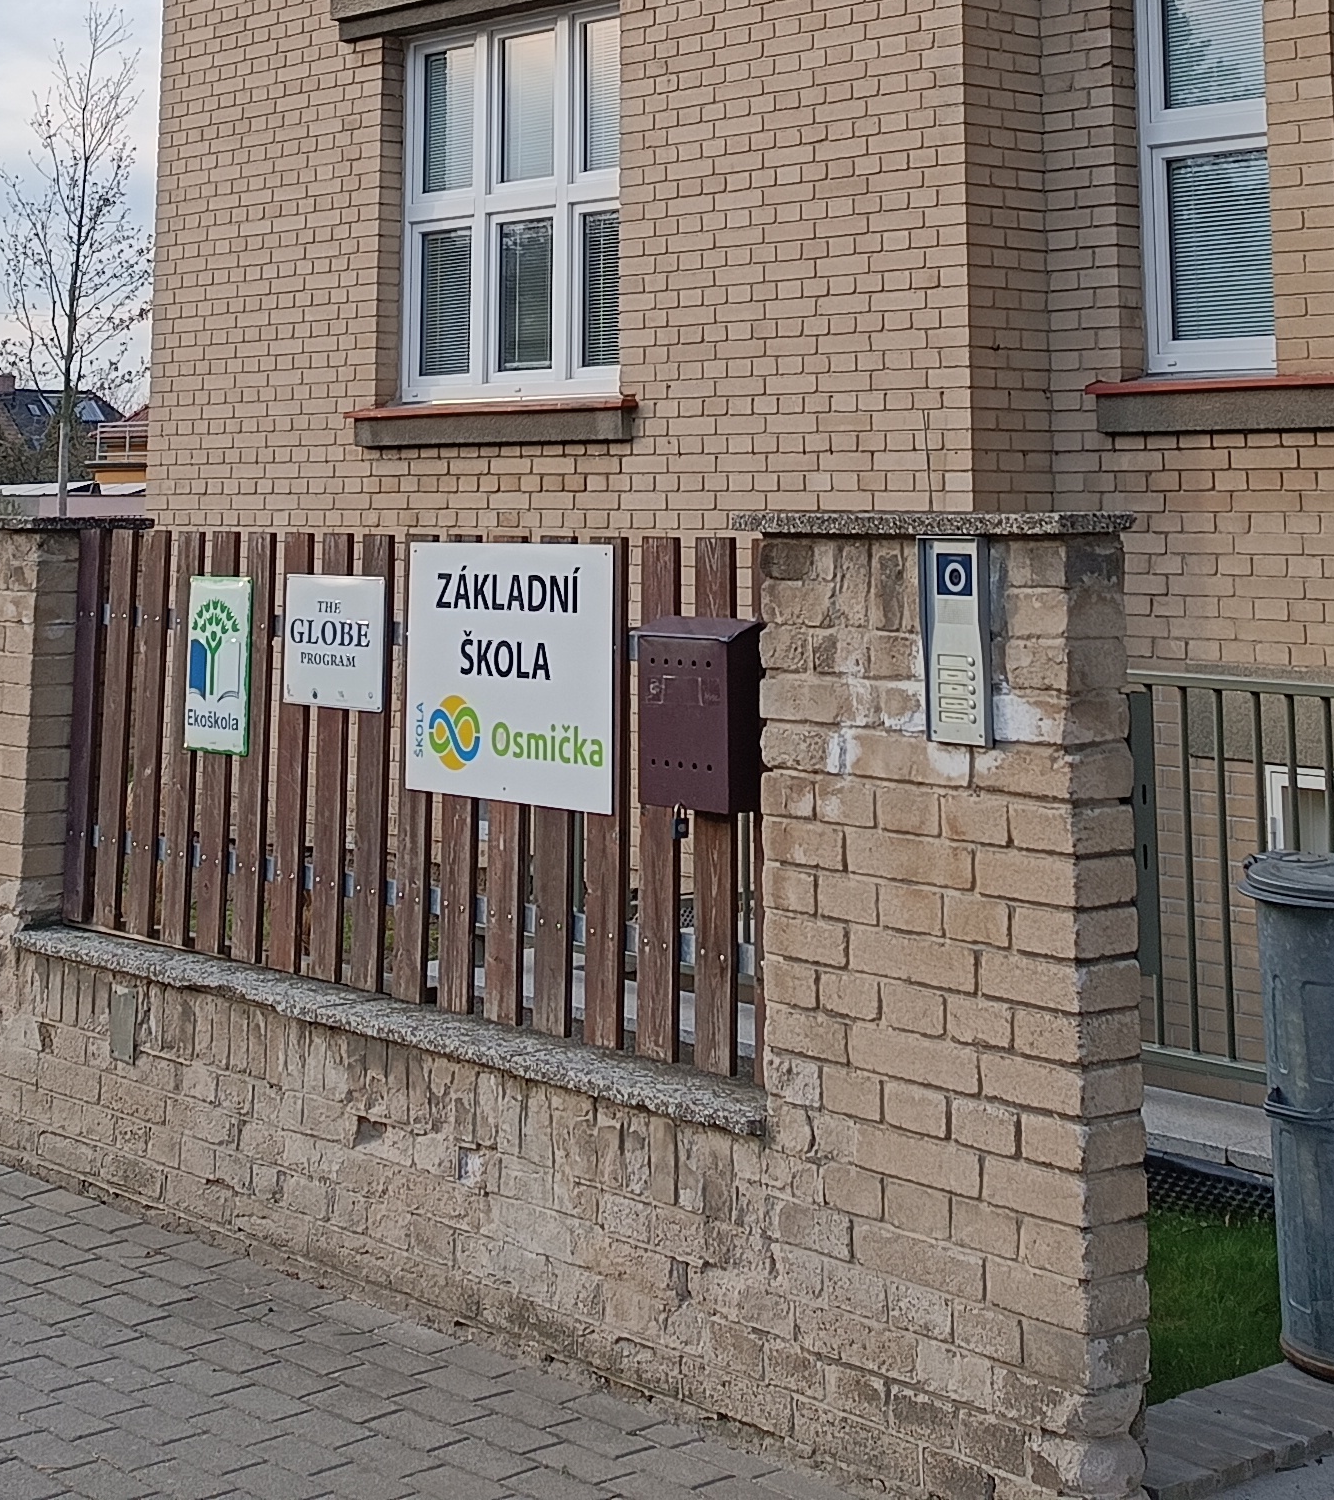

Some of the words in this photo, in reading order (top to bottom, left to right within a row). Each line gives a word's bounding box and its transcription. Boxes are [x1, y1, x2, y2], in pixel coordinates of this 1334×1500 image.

[317, 600, 342, 614] THE
[436, 565, 581, 614] ZÁKLADNÍ
[290, 618, 371, 648] GLOBE
[300, 651, 357, 668] PROGRAM
[460, 630, 551, 680] ŠKOLA
[187, 708, 239, 731] Ekoškola
[414, 702, 424, 758] ŠKOLA
[491, 722, 603, 767] Osmička
